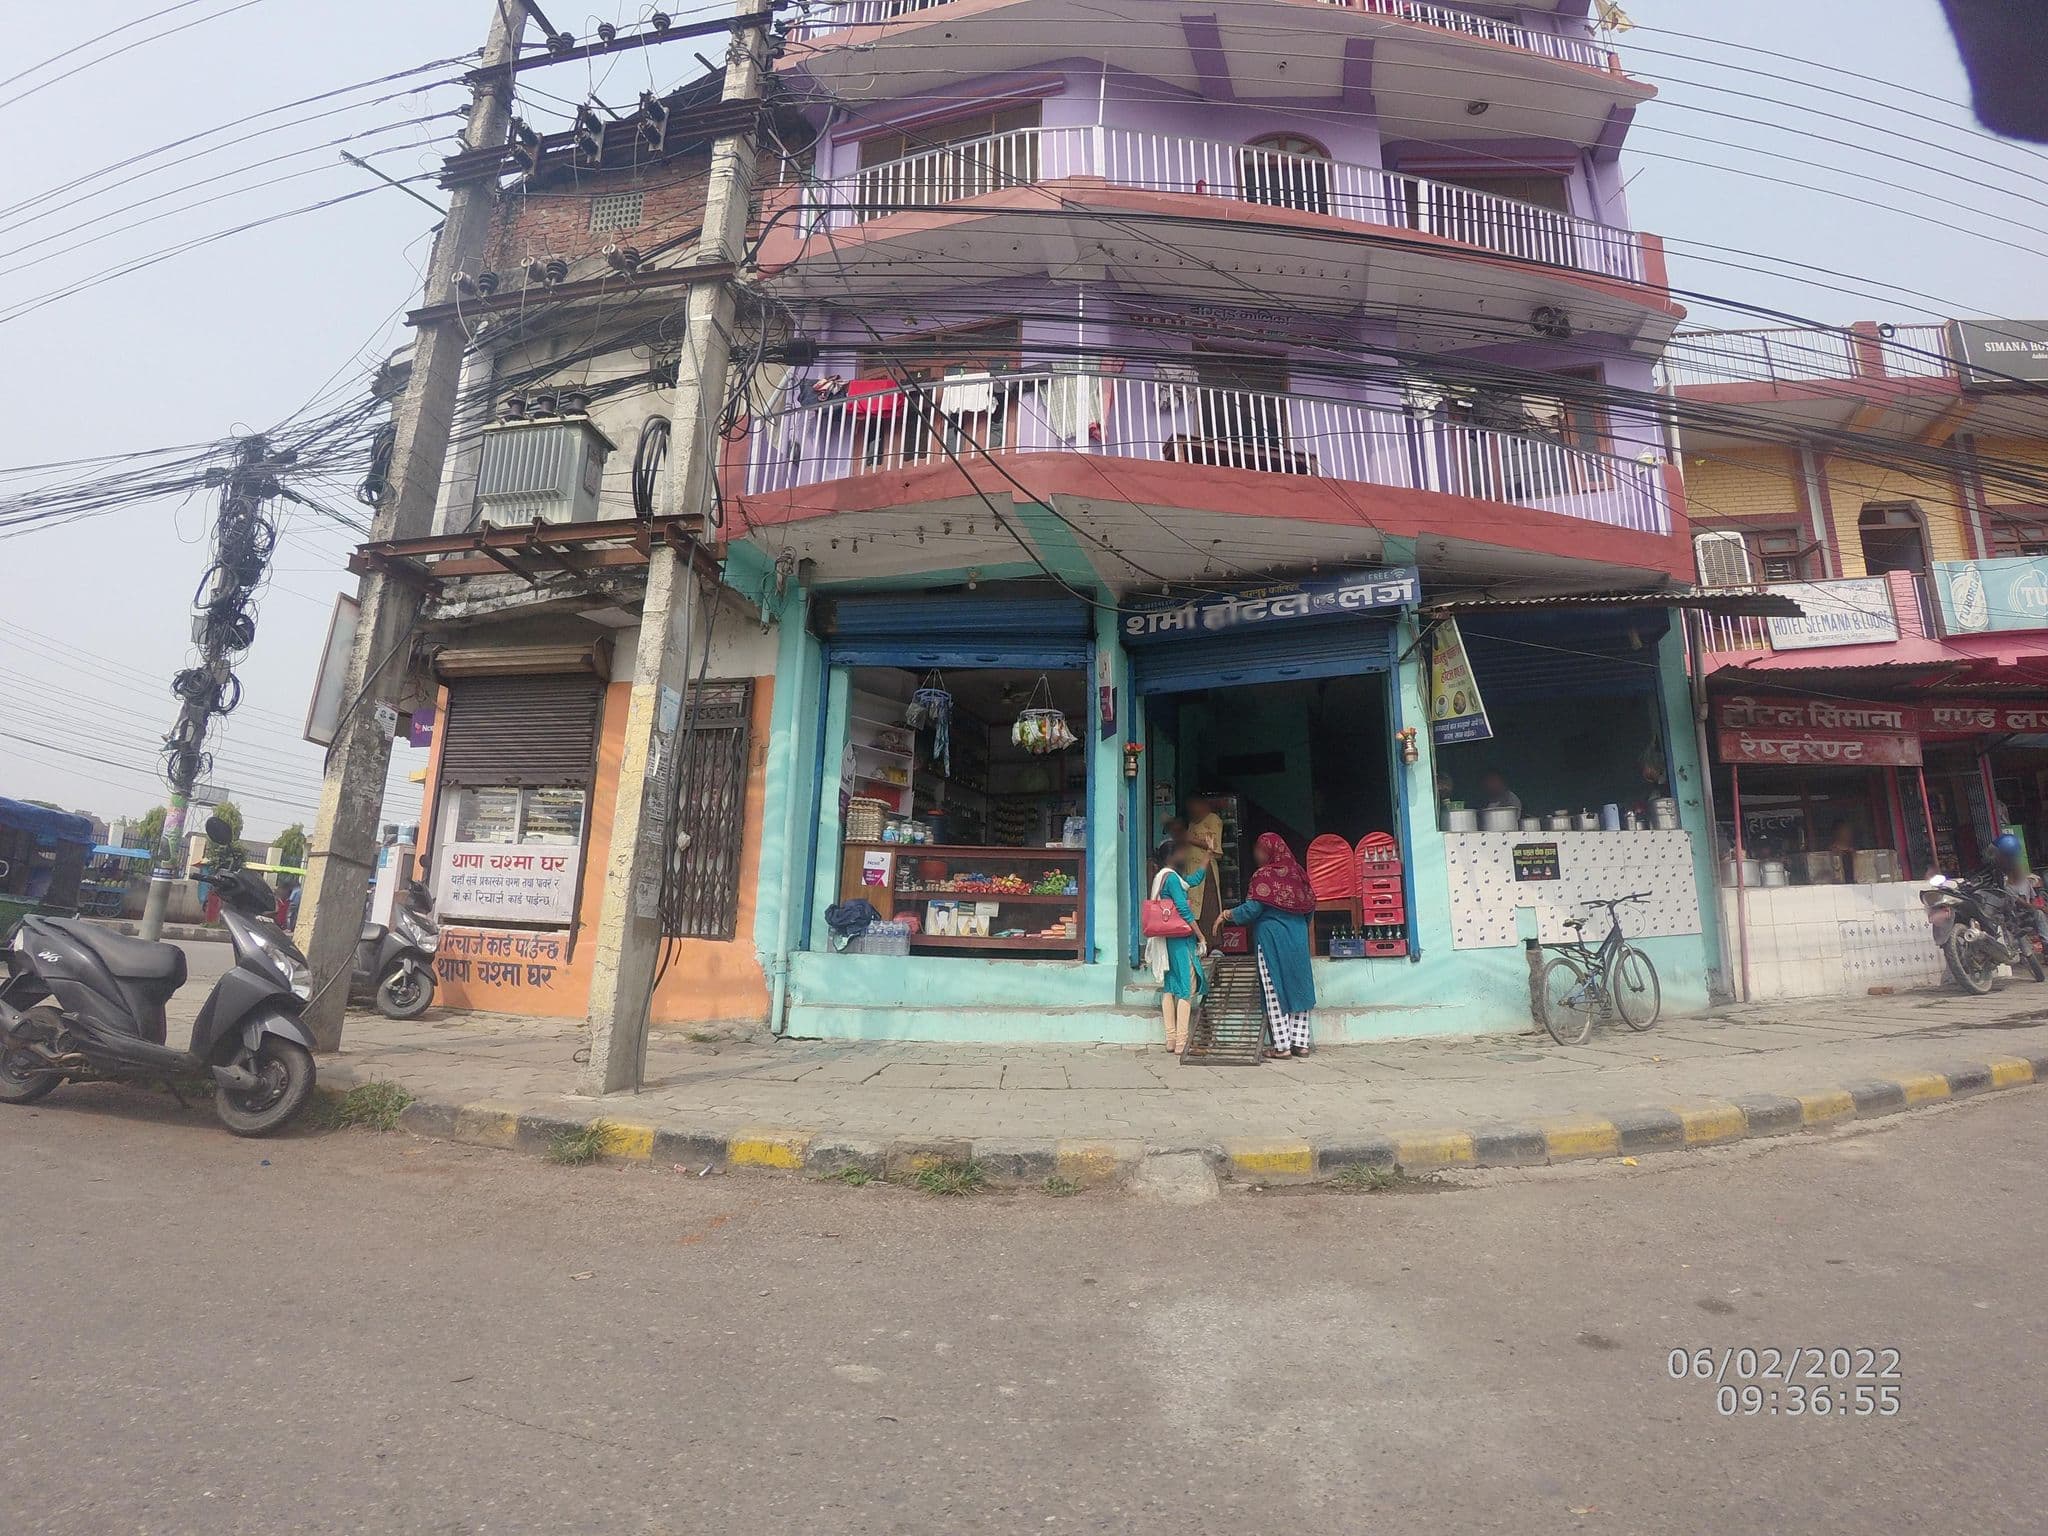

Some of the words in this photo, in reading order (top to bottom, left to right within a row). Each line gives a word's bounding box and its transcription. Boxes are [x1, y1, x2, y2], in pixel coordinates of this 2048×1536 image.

[1984, 341, 2028, 352] SIMANA
[1368, 572, 1389, 581] FREE
[1126, 604, 1198, 635] शर्मा
[1202, 592, 1310, 631] होटल
[1338, 578, 1414, 608] लज
[1808, 702, 1902, 729] सिमाना
[452, 854, 485, 869] थापा
[490, 855, 534, 871] चश्मा
[540, 856, 568, 872] घर
[444, 931, 484, 954] रिचार्ज
[487, 935, 513, 957] कार्ड
[438, 958, 472, 983] थापा
[478, 961, 523, 987] चश्मा
[527, 964, 557, 990] घर
